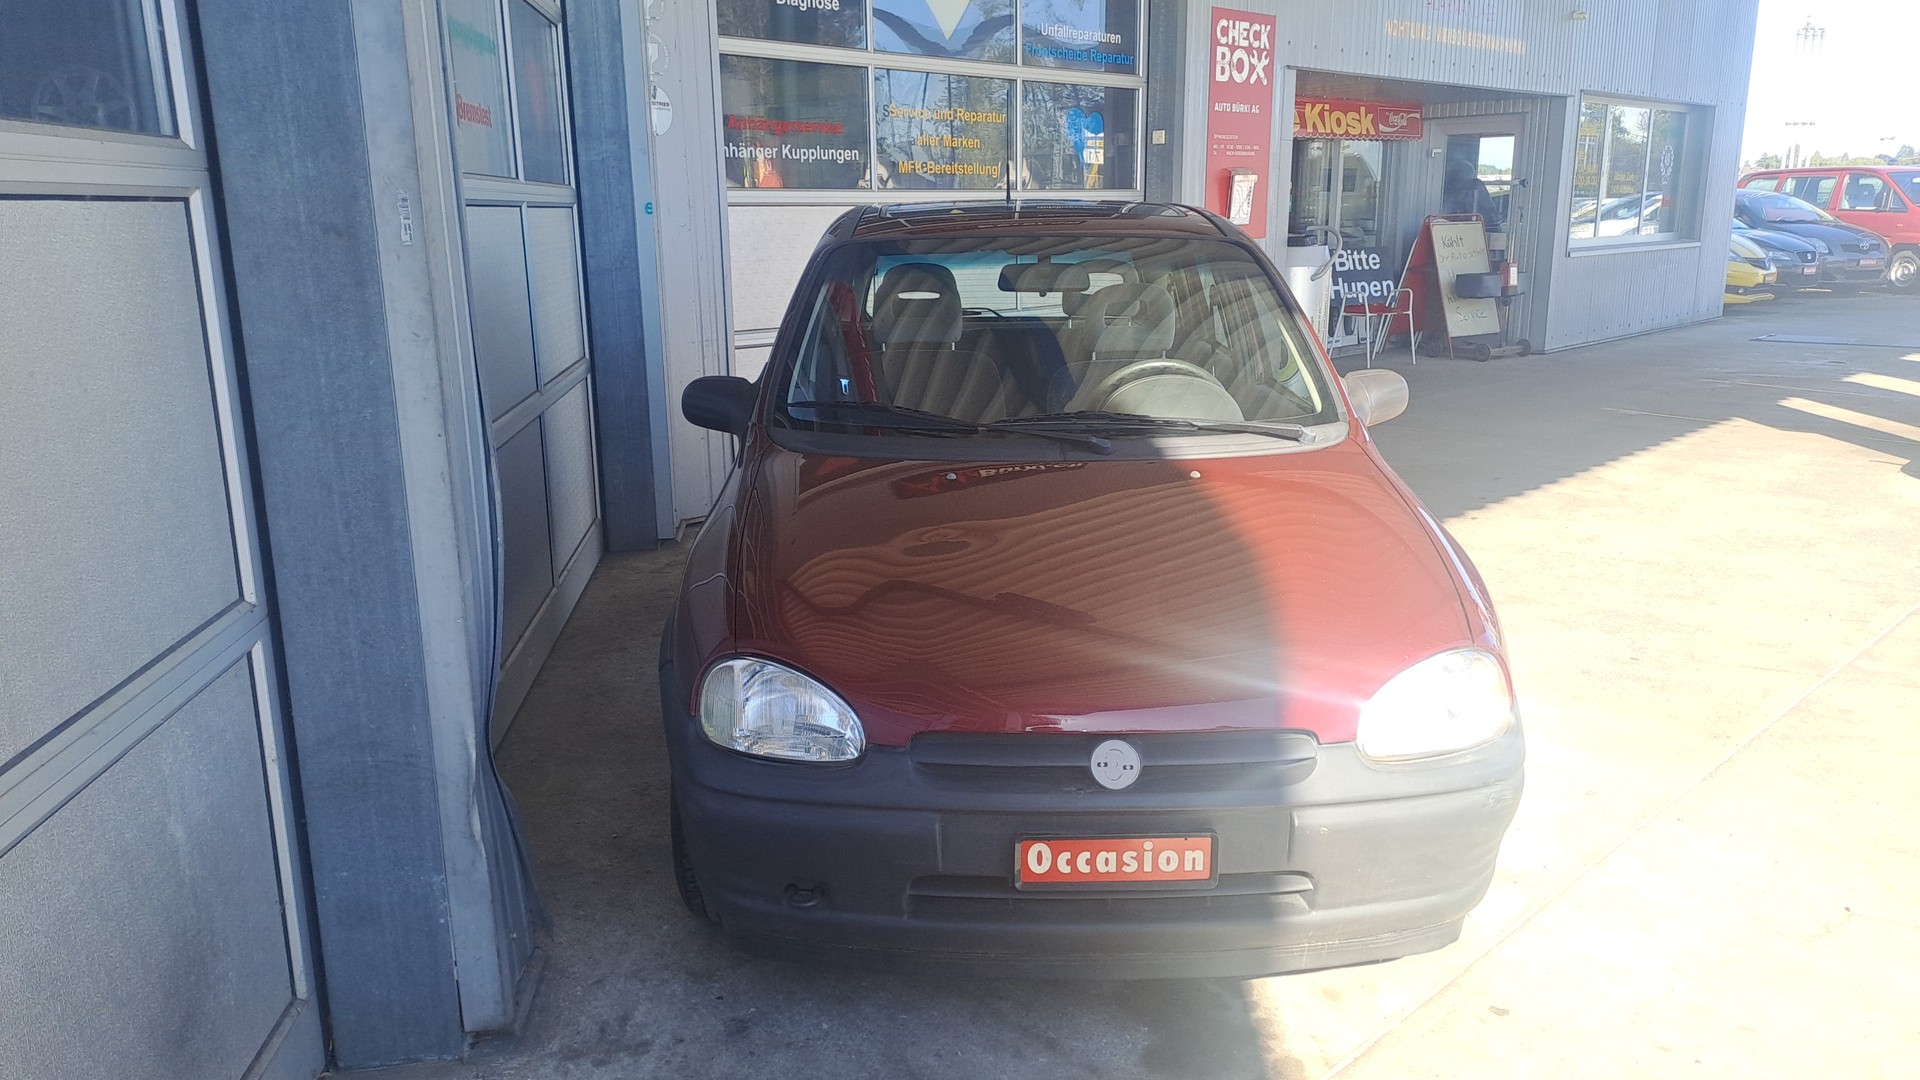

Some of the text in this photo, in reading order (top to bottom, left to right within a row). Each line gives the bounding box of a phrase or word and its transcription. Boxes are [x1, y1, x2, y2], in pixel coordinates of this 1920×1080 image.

[1041, 22, 1122, 44] Unfallreparaturen
[1216, 18, 1271, 49] CHECK
[1025, 43, 1134, 65] Frontscheibe Reparatur
[1215, 45, 1270, 86] BOX
[888, 103, 1007, 125] Service und Reparatur
[1214, 102, 1231, 112] AUTO
[1251, 104, 1260, 114] AG
[1304, 102, 1376, 135] Kiosk
[916, 133, 981, 149] aller Marken
[781, 144, 859, 164] Kupplungen
[1333, 249, 1380, 271] Bitte
[1330, 277, 1395, 303] Hupen
[1027, 841, 1205, 875] Occasion
